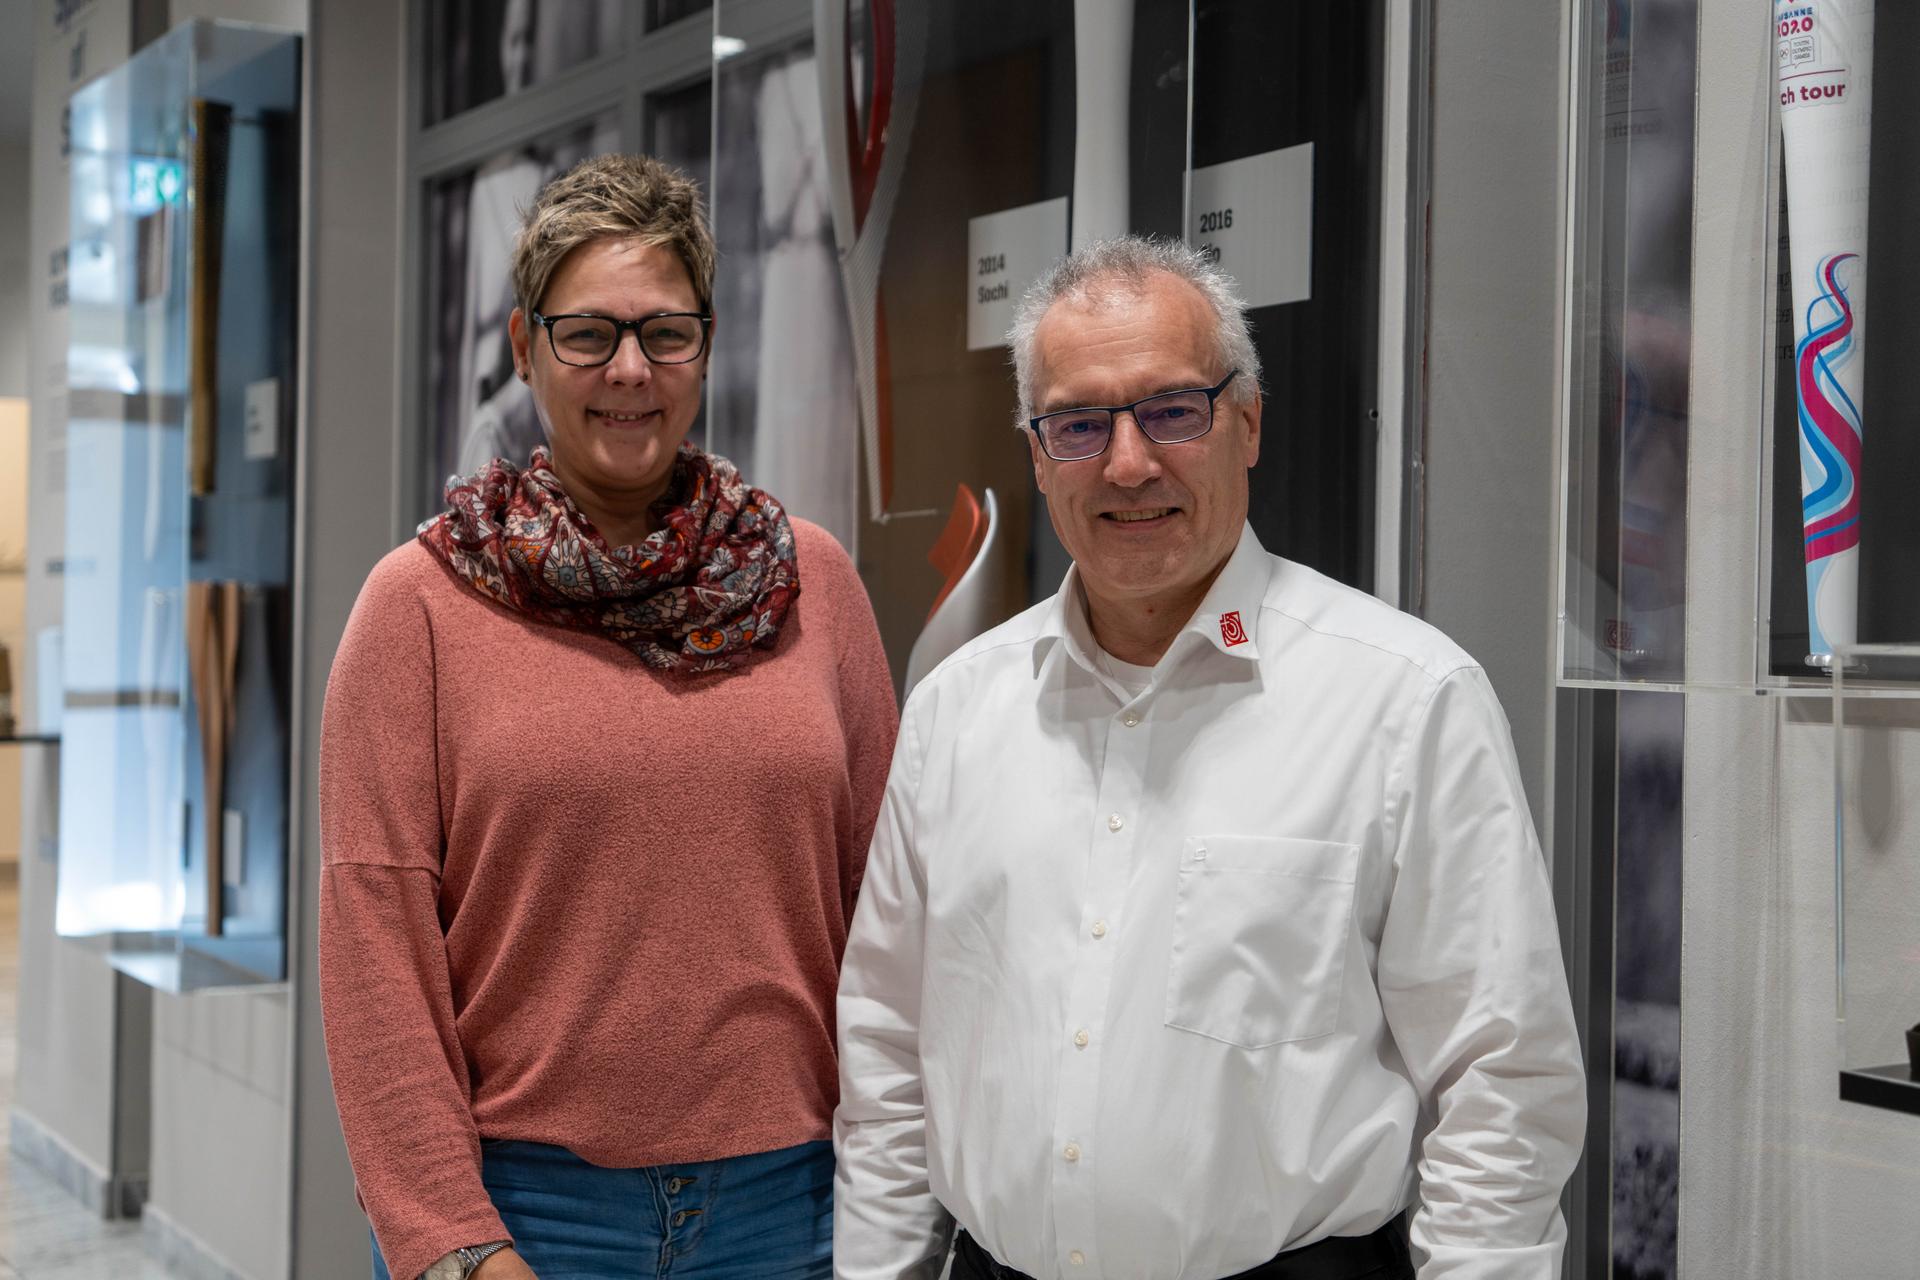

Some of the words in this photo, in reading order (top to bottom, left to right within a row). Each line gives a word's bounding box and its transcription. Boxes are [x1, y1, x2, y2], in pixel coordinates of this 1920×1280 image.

[1800, 84, 1846, 101] tour
[1199, 208, 1233, 234] 2016
[977, 254, 1006, 276] 2014
[977, 280, 1009, 305] Sochi
